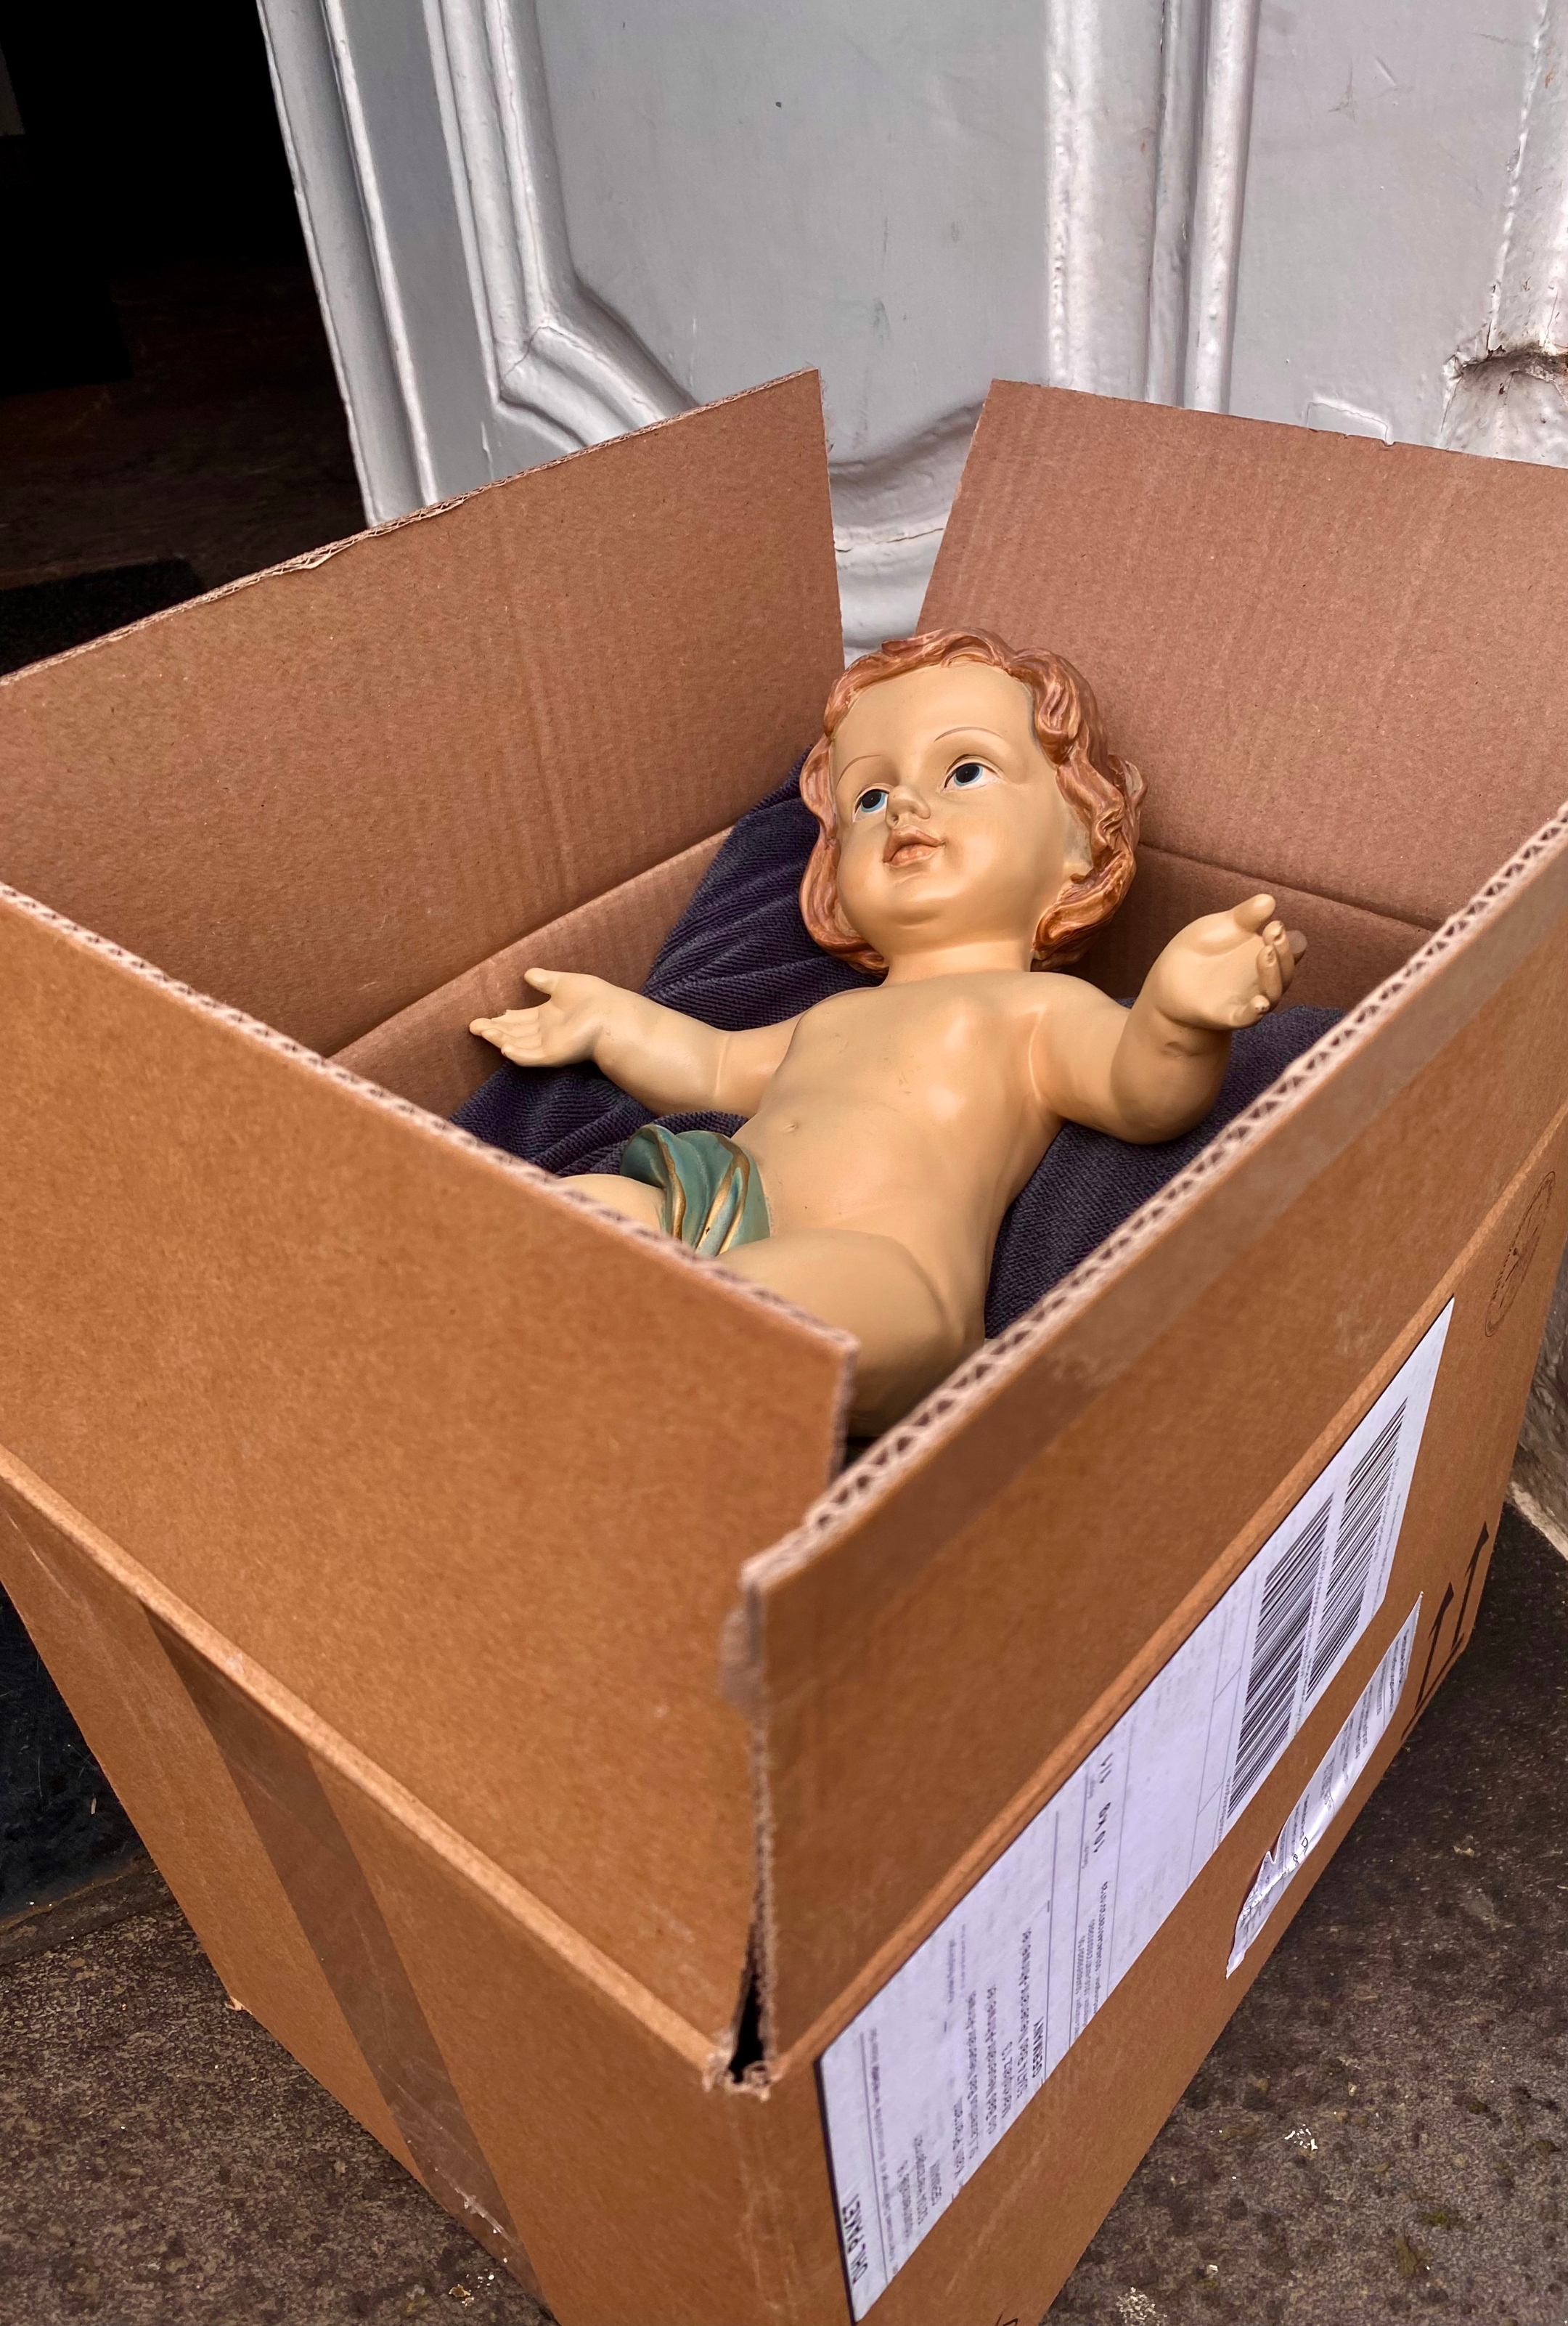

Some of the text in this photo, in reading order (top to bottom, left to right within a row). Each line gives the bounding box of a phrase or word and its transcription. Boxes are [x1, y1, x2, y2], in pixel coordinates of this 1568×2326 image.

[1098, 1752, 1113, 1784] 1/1
[1093, 1803, 1111, 1853] 10 kg
[1017, 2038, 1029, 2066] Bad
[1032, 2017, 1043, 2078] GERMANY
[1001, 2041, 1015, 2118] Marktplatz 13
[1016, 2060, 1028, 2100] 53474
[986, 2093, 997, 2121] Bad
[842, 2195, 868, 2285] DHL PAKET
